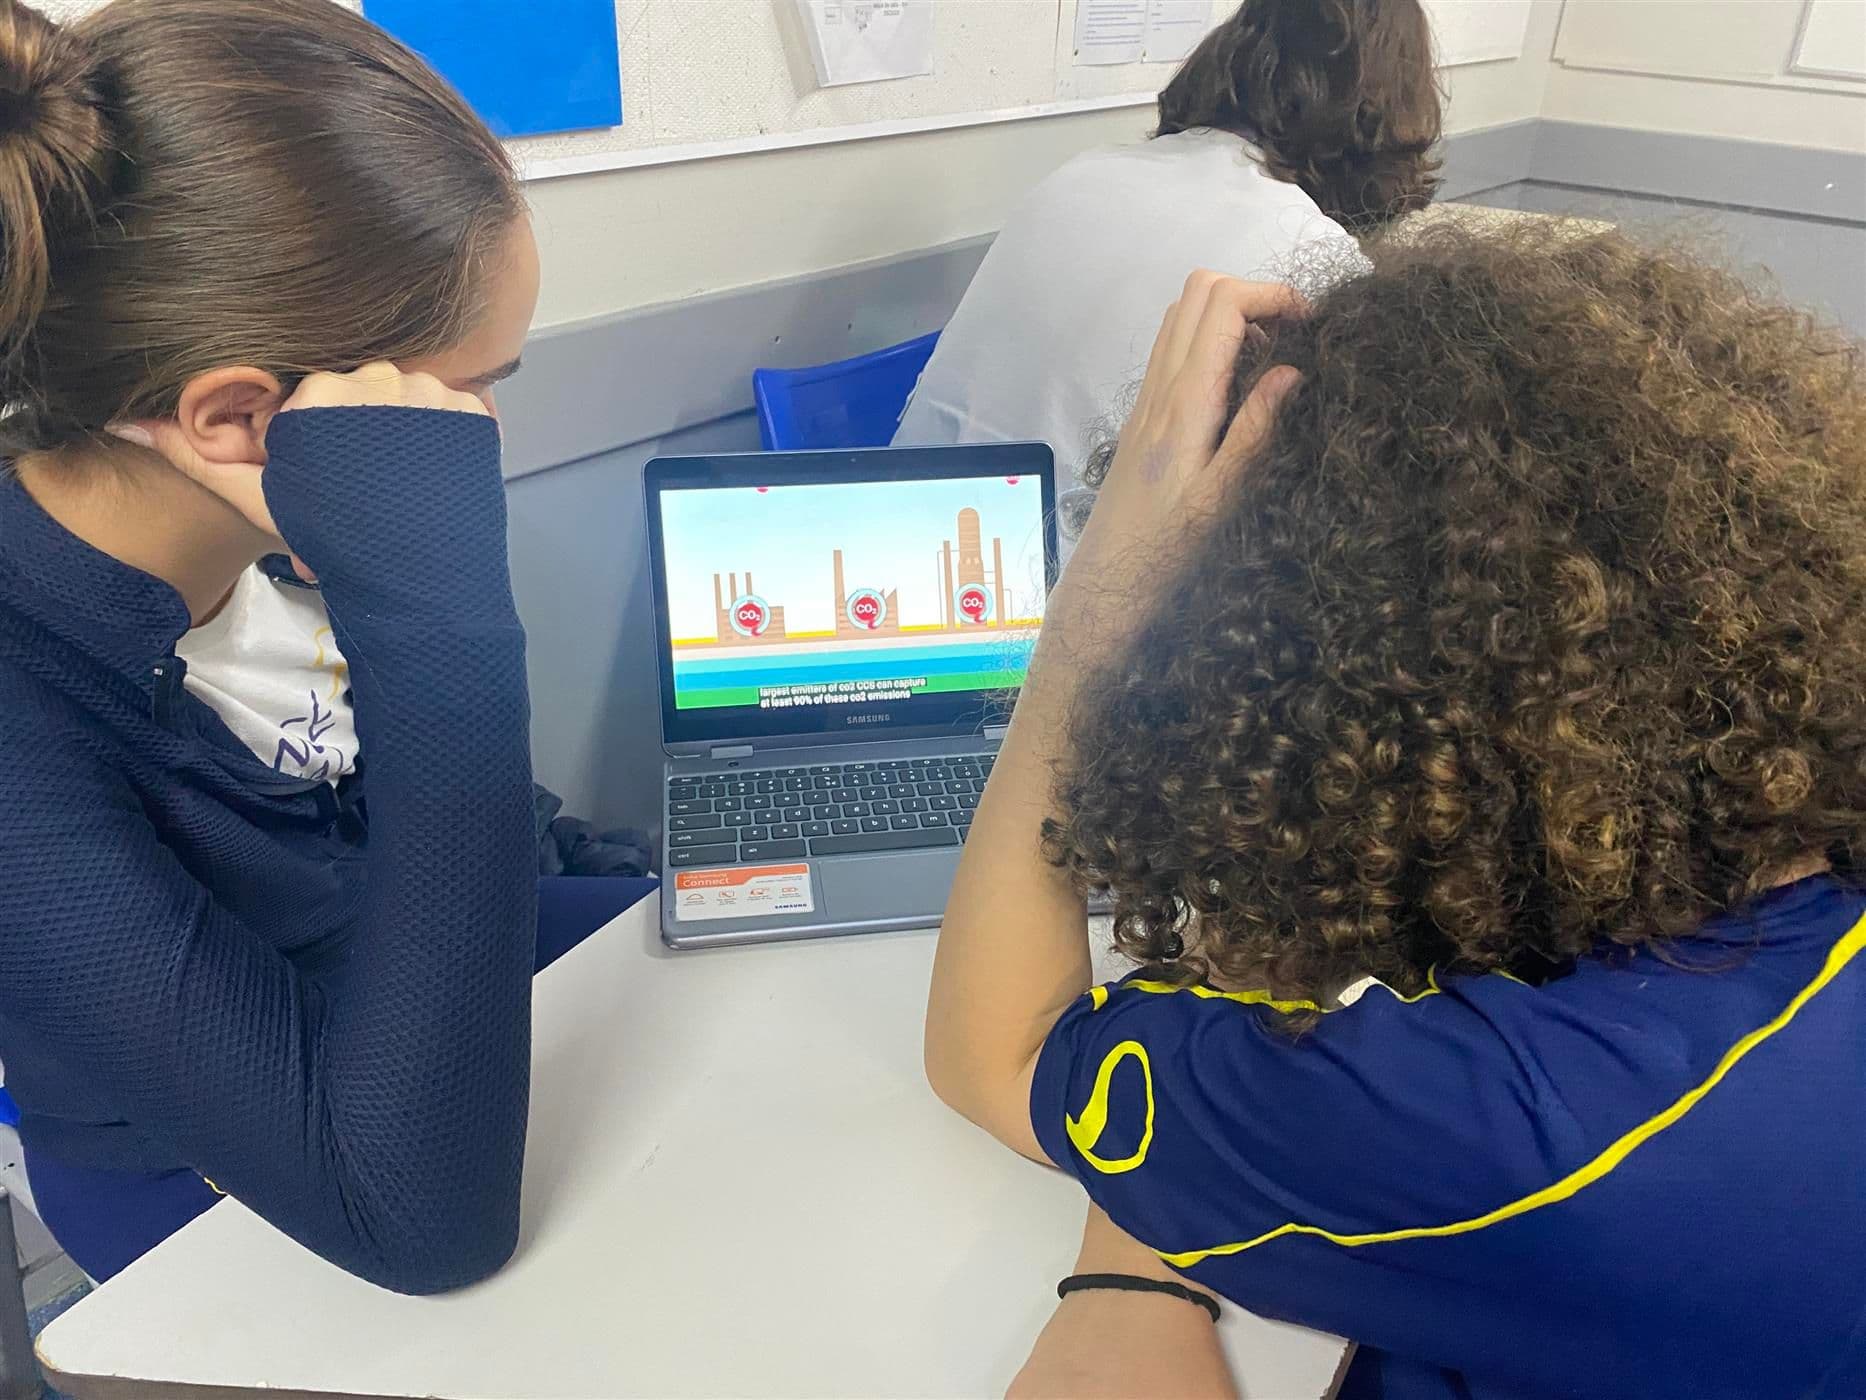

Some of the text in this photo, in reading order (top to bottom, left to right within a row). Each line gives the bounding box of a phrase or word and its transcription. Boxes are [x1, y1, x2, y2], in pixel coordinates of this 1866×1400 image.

[760, 687, 790, 697] largest
[791, 685, 827, 695] emitters
[828, 683, 838, 692] of
[839, 682, 855, 692] co2
[876, 680, 893, 689] can
[894, 678, 926, 689] capture
[760, 690, 911, 708] at least 90% of these co2 emissions
[846, 714, 890, 724] SAMSUNG
[683, 878, 729, 888] Connect
